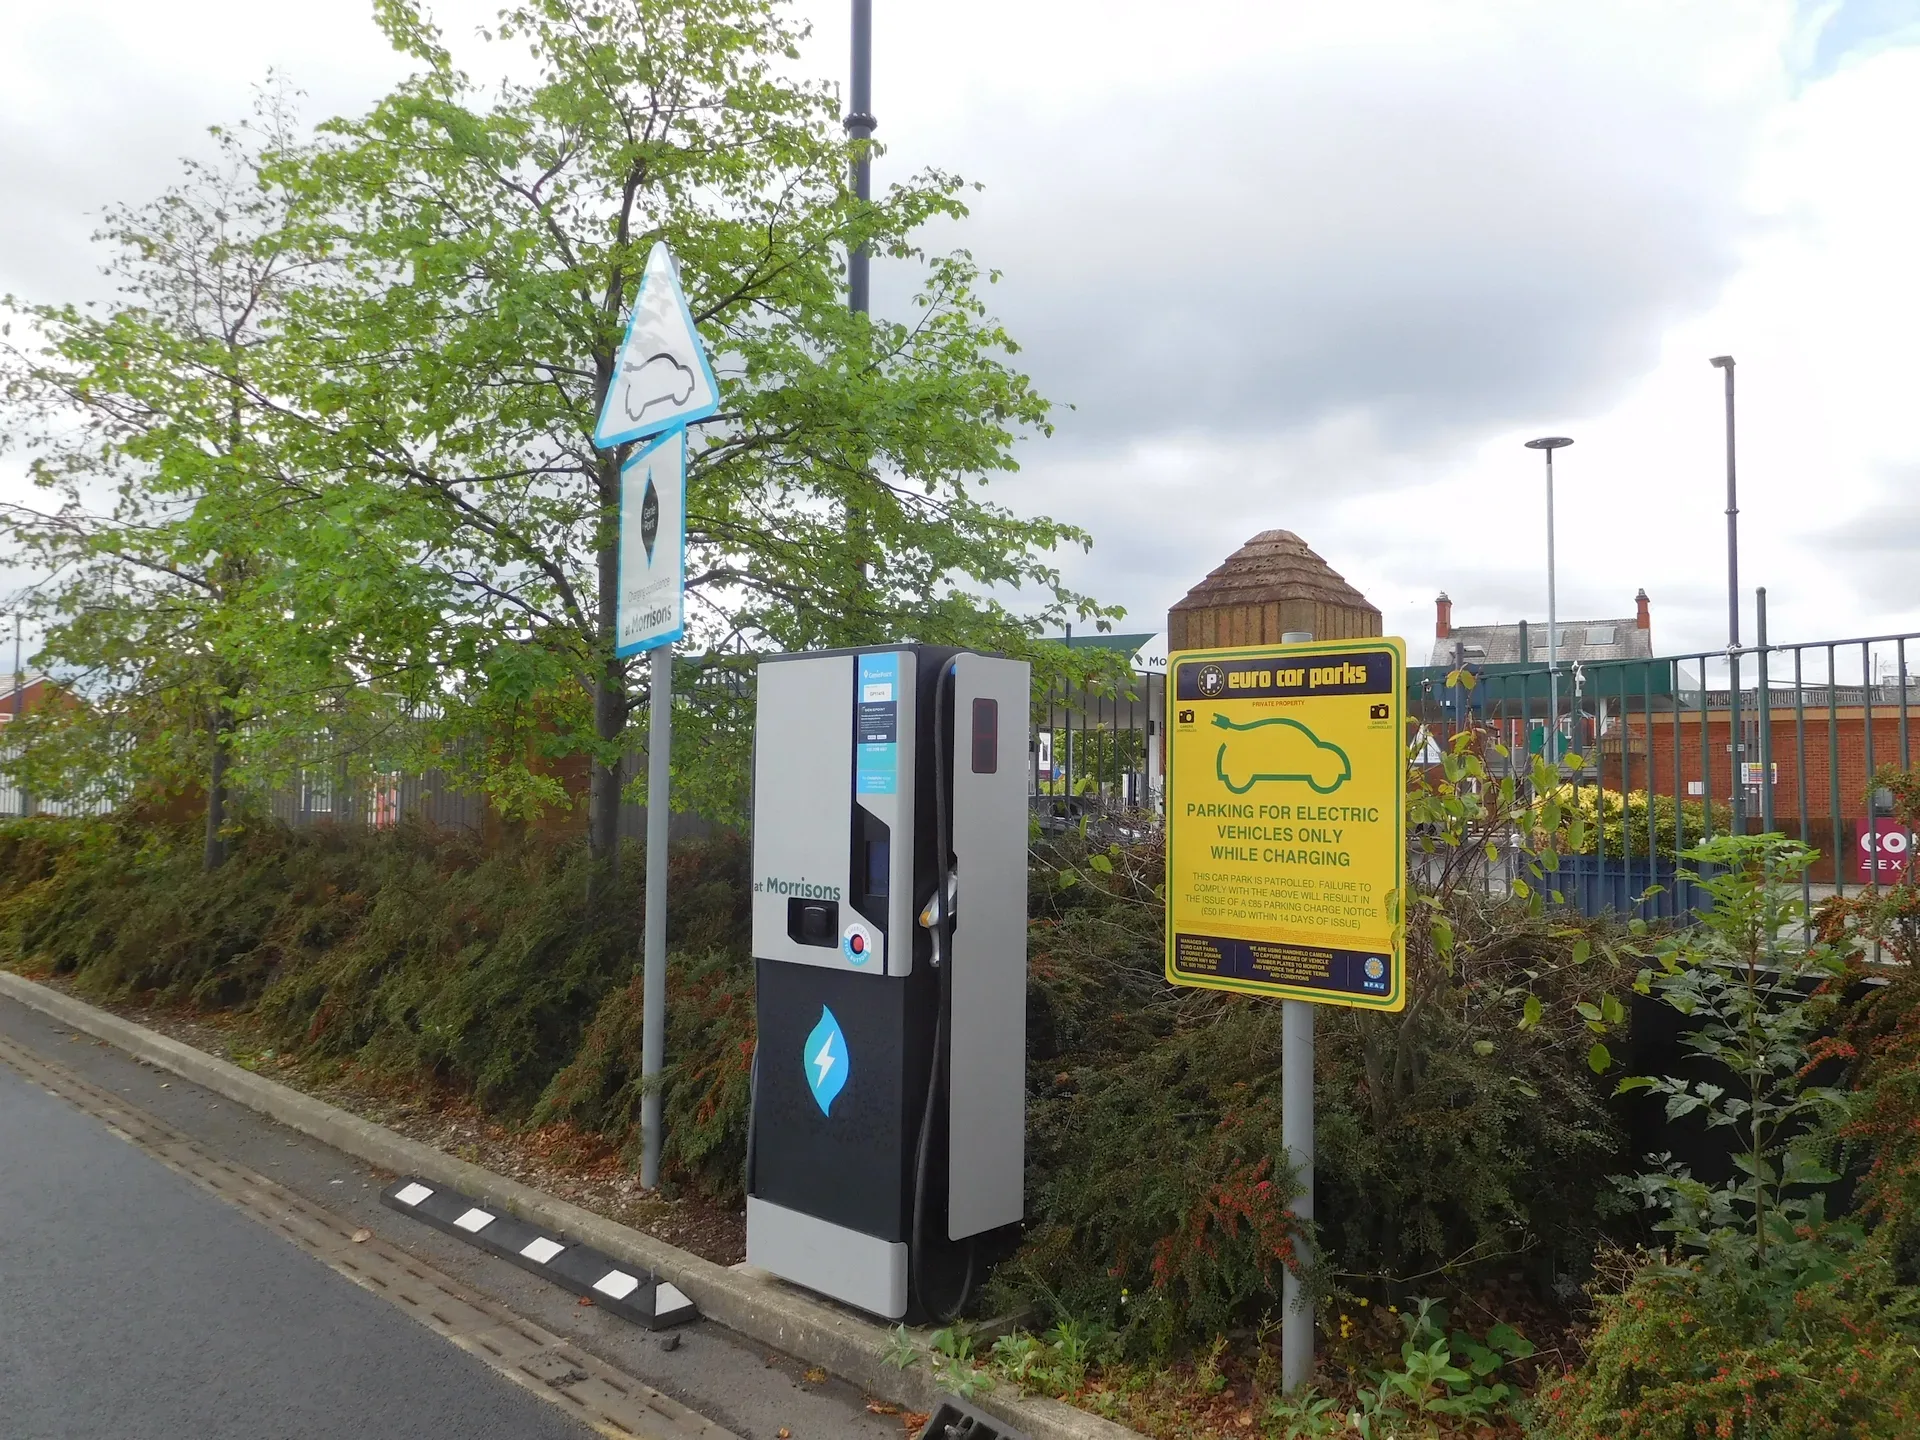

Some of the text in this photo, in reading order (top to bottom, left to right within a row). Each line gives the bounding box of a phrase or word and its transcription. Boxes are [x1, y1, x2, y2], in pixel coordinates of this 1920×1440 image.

[644, 503, 656, 519] Genie
[644, 518, 654, 531] Point
[625, 605, 671, 636] at Morrisons
[1228, 670, 1271, 688] euro
[1276, 669, 1305, 688] car
[1310, 662, 1367, 688] parks
[1187, 804, 1379, 822] PARKING FOR ELECTRIC
[1217, 825, 1343, 843] VEHICLES ONLY
[1861, 832, 1918, 853] CO
[1211, 846, 1350, 867] WHILE CHARGING
[754, 877, 841, 901] at Morrisons
[1193, 872, 1210, 881] THIS
[1212, 873, 1229, 882] CAR
[1231, 875, 1252, 883] PARK
[1319, 881, 1356, 891] FAILURE
[1358, 883, 1371, 892] TO
[1194, 884, 1370, 904] COMPLY WITH THE ABOVE WILL RESULT IN
[1185, 894, 1200, 903] THE
[1202, 896, 1225, 904] ISSUE
[1227, 898, 1239, 906] OF
[1248, 900, 1262, 908] £85
[1264, 901, 1301, 912] PARKING
[1303, 904, 1340, 914] CHARGE
[1343, 907, 1377, 918] NOTICE
[1201, 907, 1216, 916] (£50
[1228, 910, 1246, 919] PAID
[1248, 912, 1277, 921] WITHIN
[1280, 914, 1289, 922] 14
[1291, 915, 1314, 924] DAYS
[1316, 917, 1328, 925] OF
[1331, 918, 1360, 930] ISSUE)
